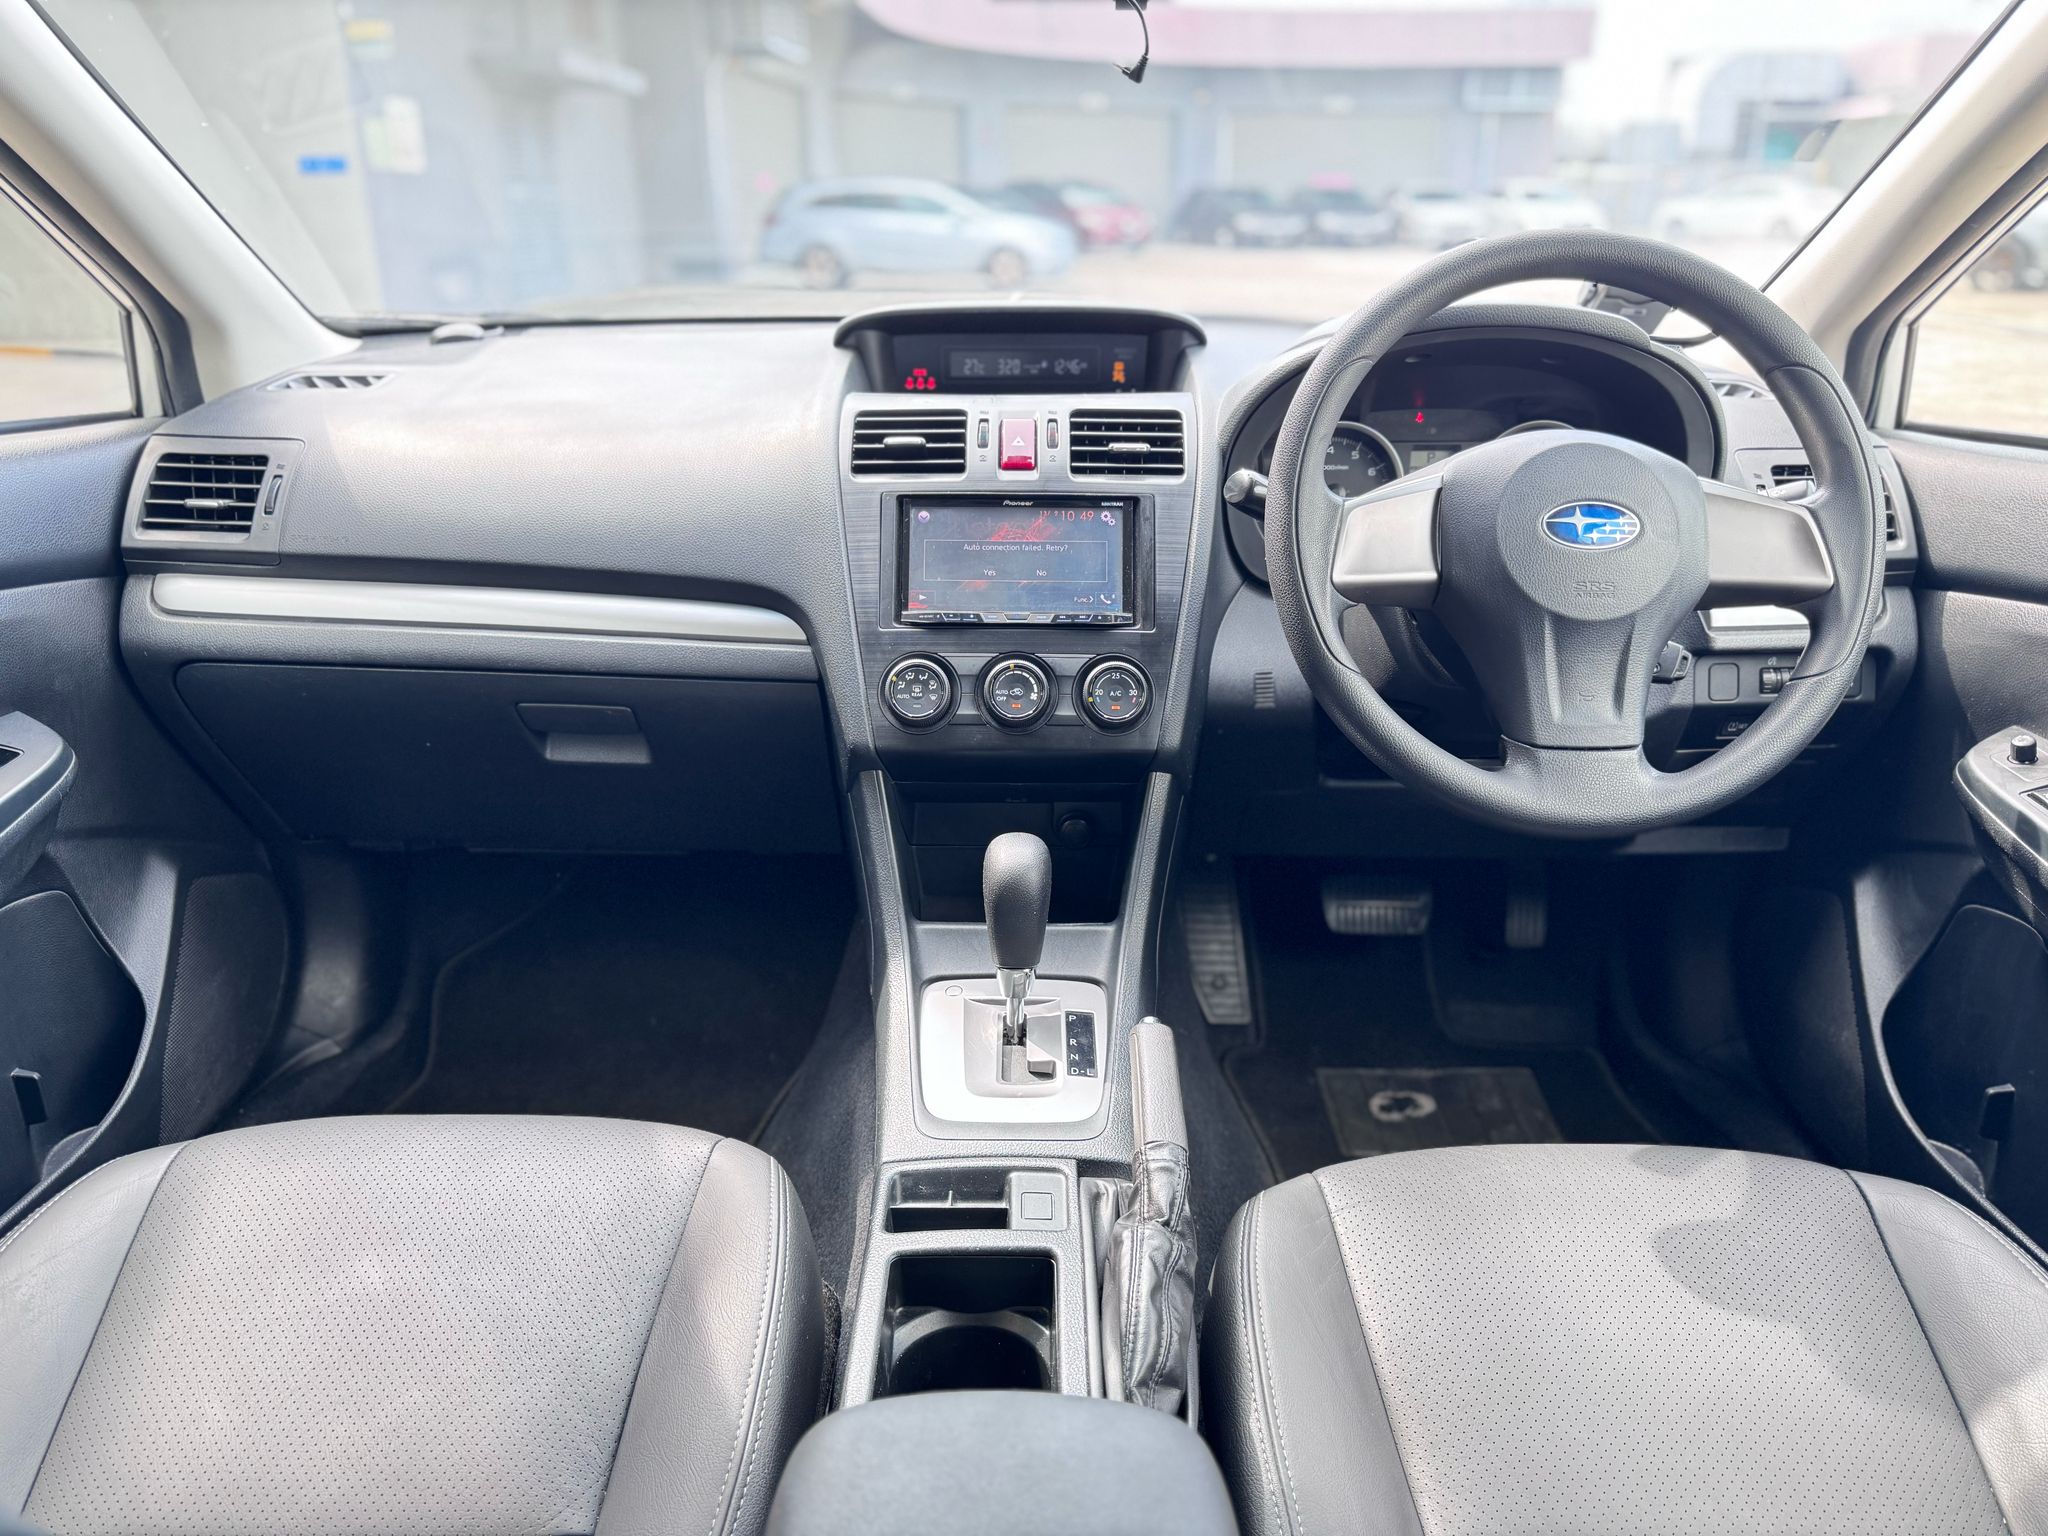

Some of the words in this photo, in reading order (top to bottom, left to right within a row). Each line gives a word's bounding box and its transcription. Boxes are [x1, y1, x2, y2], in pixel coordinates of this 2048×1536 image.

[1351, 451, 1359, 460] 5
[1367, 468, 1376, 477] 6
[963, 543, 980, 551] Auto
[982, 543, 1020, 551] connection
[1022, 543, 1043, 551] failed.
[1046, 544, 1069, 553] Retry?
[983, 569, 997, 577] Yes
[1036, 569, 1047, 577] No
[1572, 581, 1615, 590] SRS
[1068, 1014, 1077, 1022] P
[1069, 1038, 1078, 1047] R
[1070, 1053, 1079, 1061] N
